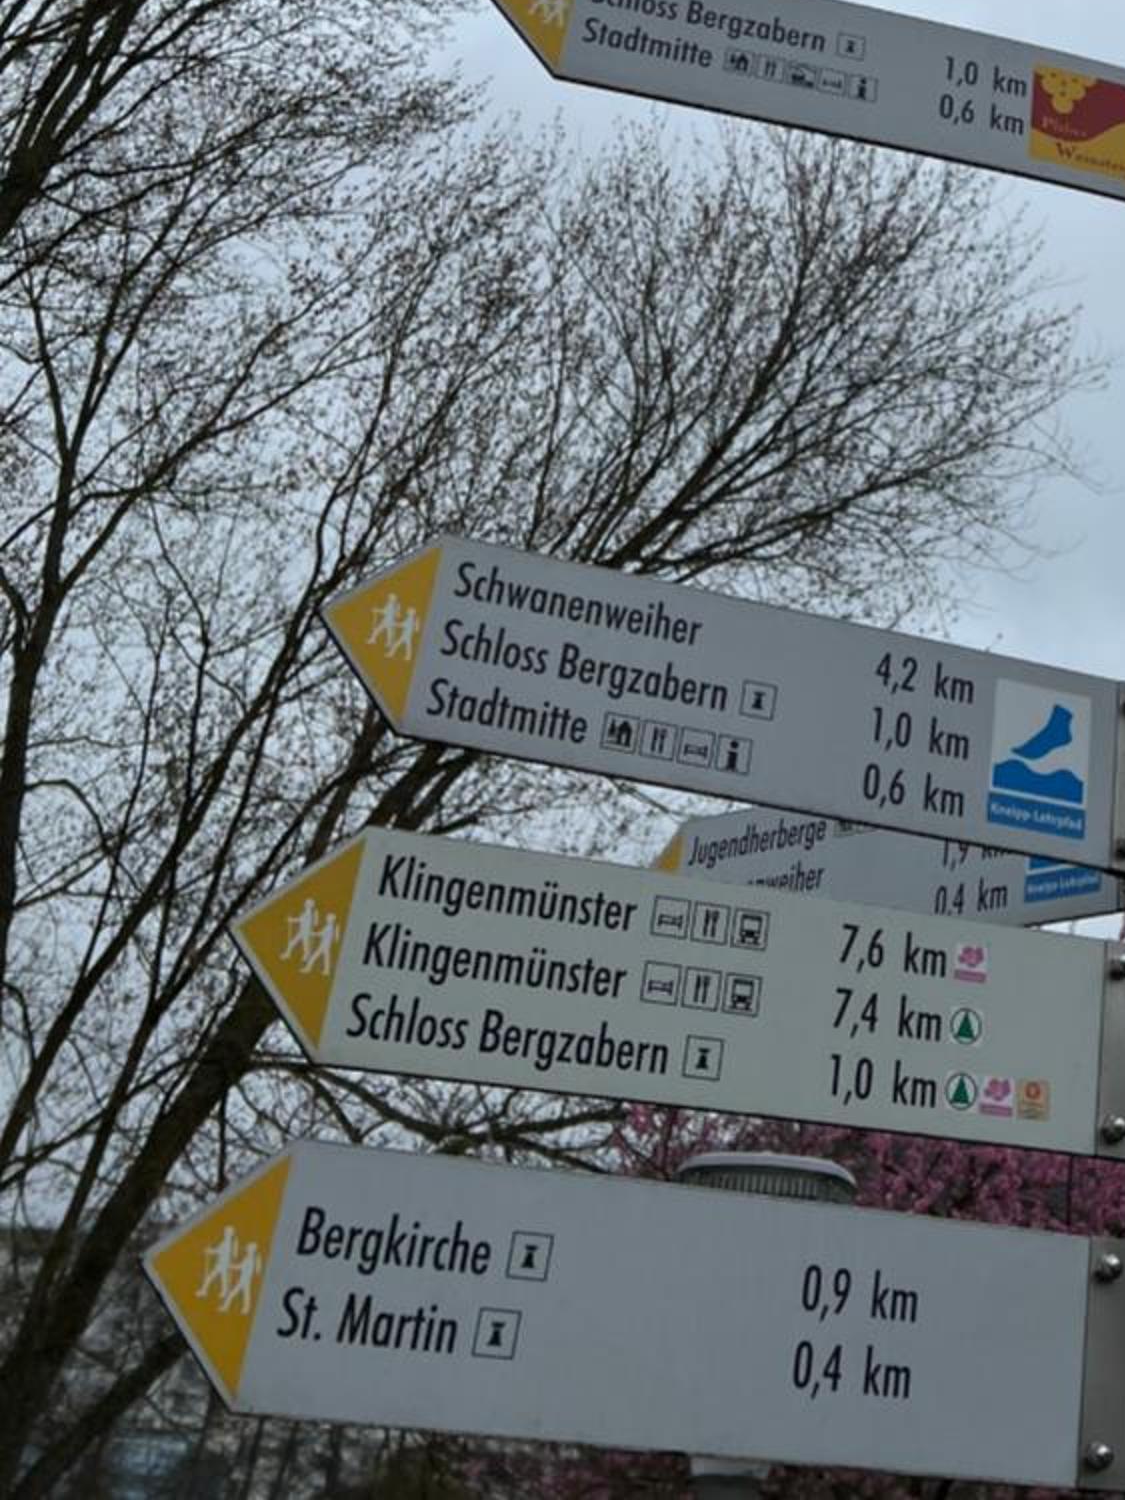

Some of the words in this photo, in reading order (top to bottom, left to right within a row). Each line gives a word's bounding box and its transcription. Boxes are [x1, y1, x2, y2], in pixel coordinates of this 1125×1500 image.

[582, 17, 713, 68] Stadtmitte
[939, 94, 974, 125] 0,6
[990, 103, 1024, 135] km
[686, 0, 826, 52] Bergzabern
[945, 55, 978, 87] 1,0
[993, 65, 1027, 96] km
[440, 618, 549, 675] Schloss
[557, 642, 728, 712] Bergzabern
[873, 706, 912, 751] 1,0
[928, 716, 970, 761] km
[453, 561, 703, 646] Schwanenweiher
[875, 652, 918, 695] 4,2
[934, 661, 974, 704] km
[426, 677, 588, 744] Stadtmitte
[863, 763, 906, 809] 0,6
[923, 772, 965, 818] km
[688, 818, 827, 868] Jugendherberge
[977, 876, 1008, 912] km
[377, 854, 638, 932] Klingenmünster
[839, 923, 884, 974] 7,6
[903, 931, 947, 978] km
[362, 922, 628, 998] Klingenmünster
[833, 986, 878, 1039] 7,4
[898, 993, 942, 1042] km
[345, 992, 470, 1050] Schloss
[478, 1008, 669, 1075] Bergzabern
[830, 1053, 874, 1106] 1,0
[892, 1059, 937, 1108] km
[296, 1206, 491, 1276] Bergkirche
[802, 1264, 852, 1322] 0,9
[870, 1268, 918, 1324] km
[276, 1286, 321, 1342] St.
[336, 1292, 458, 1354] Martin
[793, 1340, 843, 1400] 0,4
[863, 1344, 911, 1400] km
